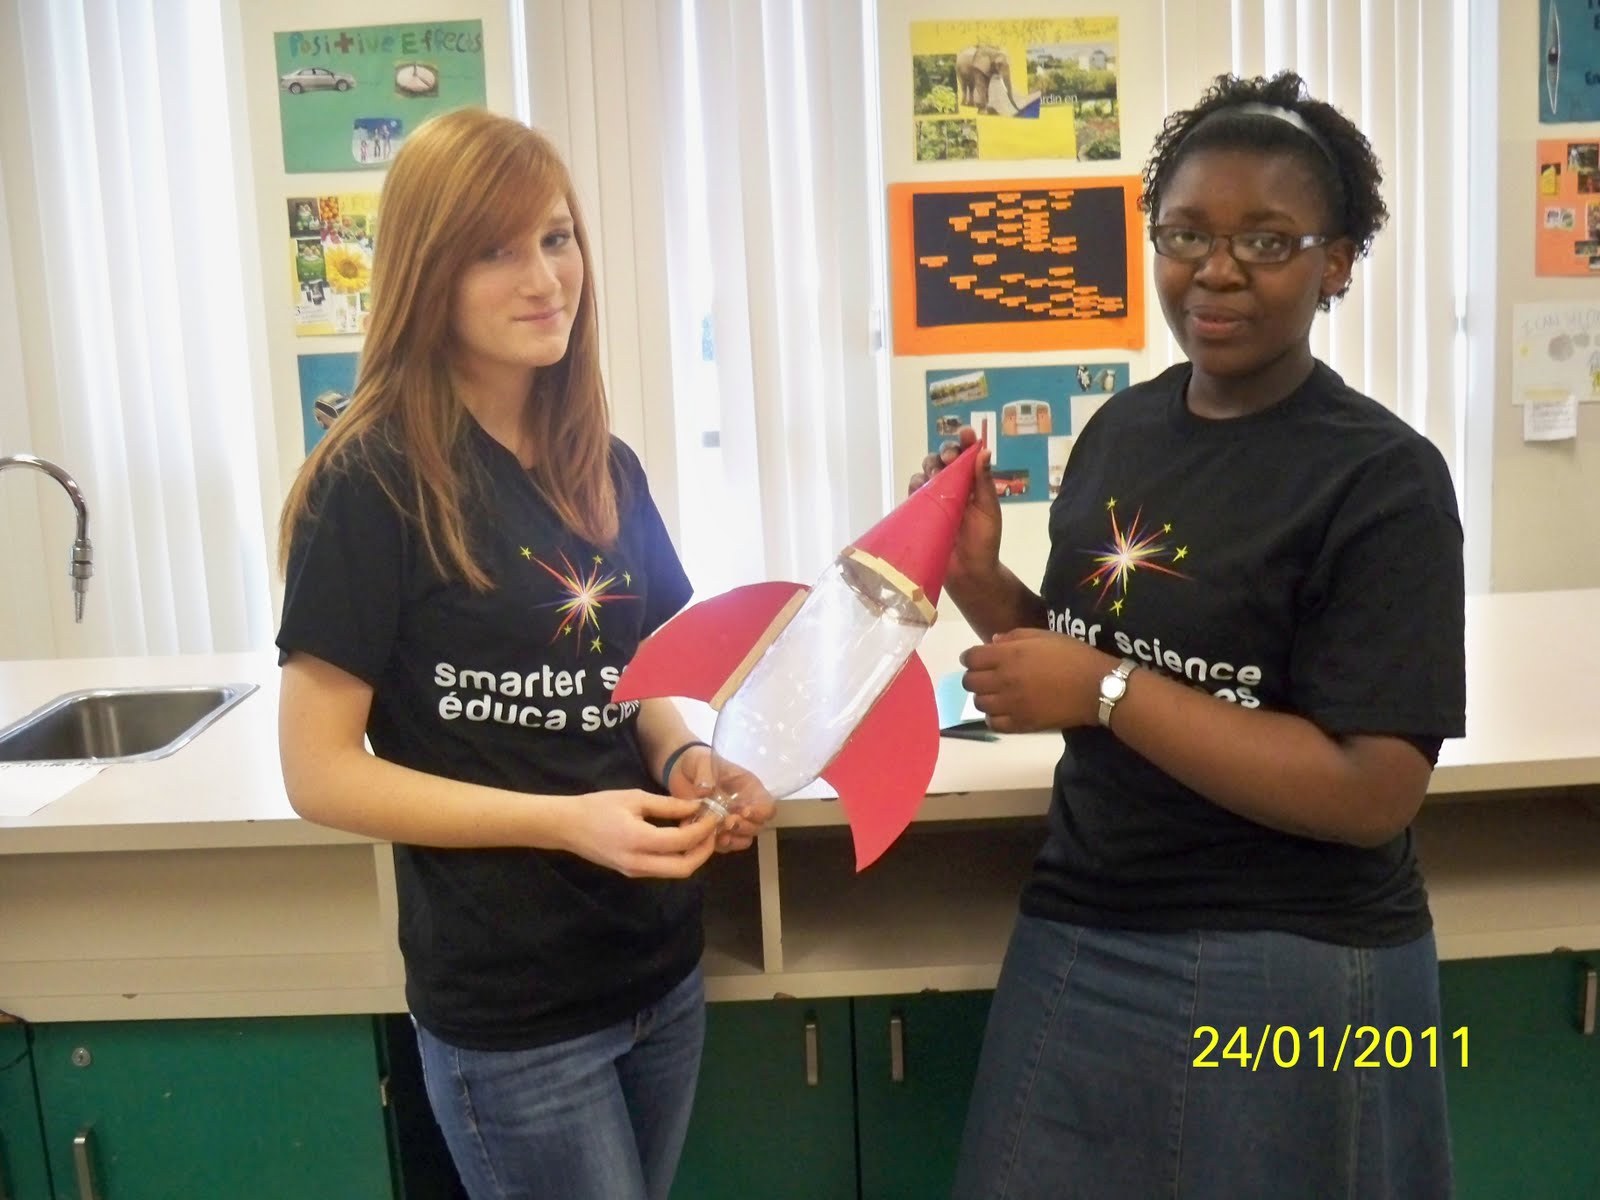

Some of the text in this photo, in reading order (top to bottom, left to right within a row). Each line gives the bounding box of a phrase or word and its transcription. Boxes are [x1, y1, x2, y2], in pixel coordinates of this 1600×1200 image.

[1047, 607, 1262, 686] arter science
[434, 662, 586, 698] smarter
[438, 691, 567, 731] éduca
